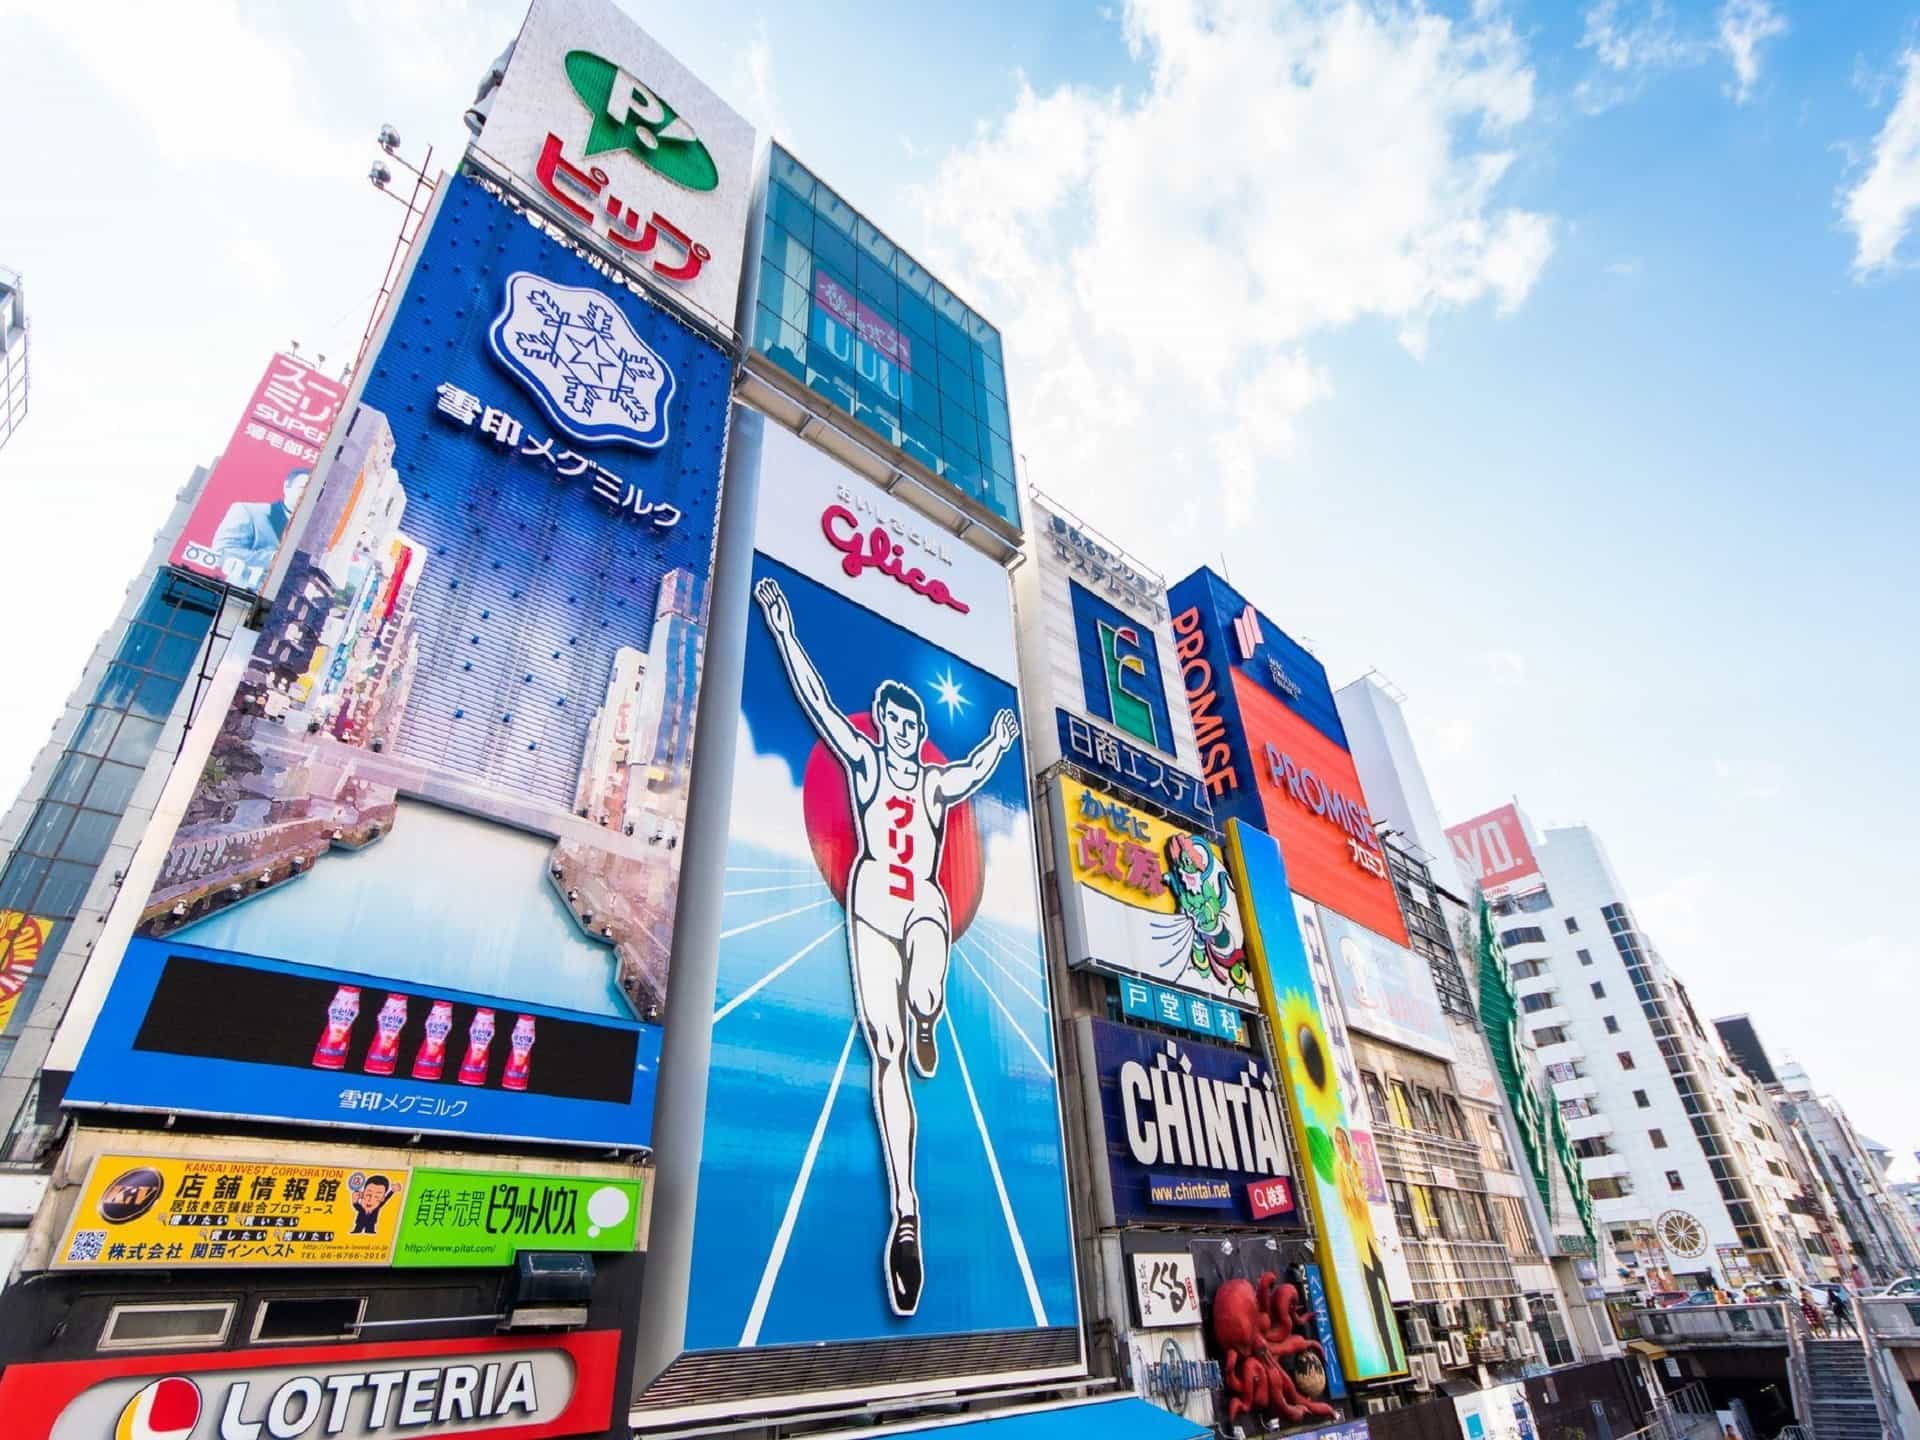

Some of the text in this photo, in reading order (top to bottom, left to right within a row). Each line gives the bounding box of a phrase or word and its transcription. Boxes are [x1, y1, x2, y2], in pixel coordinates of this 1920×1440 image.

[536, 131, 712, 281] ピップ
[264, 380, 333, 421] ミリ
[272, 359, 341, 407] スー
[437, 382, 681, 527] 雪印メグミルク
[1172, 606, 1239, 796] PROMISE
[1069, 715, 1214, 816] 日商エステム
[1265, 741, 1379, 852] PROMISE
[1079, 789, 1151, 841] かぜに
[886, 795, 915, 902] グリコ
[1074, 822, 1166, 896] 改源
[1127, 983, 1238, 1034] 戸堂歯科
[338, 1089, 468, 1118] 雪印メグミルク
[1120, 1050, 1290, 1177] CHINTAI
[176, 1174, 341, 1202] 店舗情報館
[185, 1163, 344, 1178] KANSAI INVEST CORPORATION
[486, 1183, 579, 1236] ピタットハウス
[108, 1242, 295, 1260] 株式会社 関西インベスト
[219, 1361, 538, 1440] LOTTERIA
